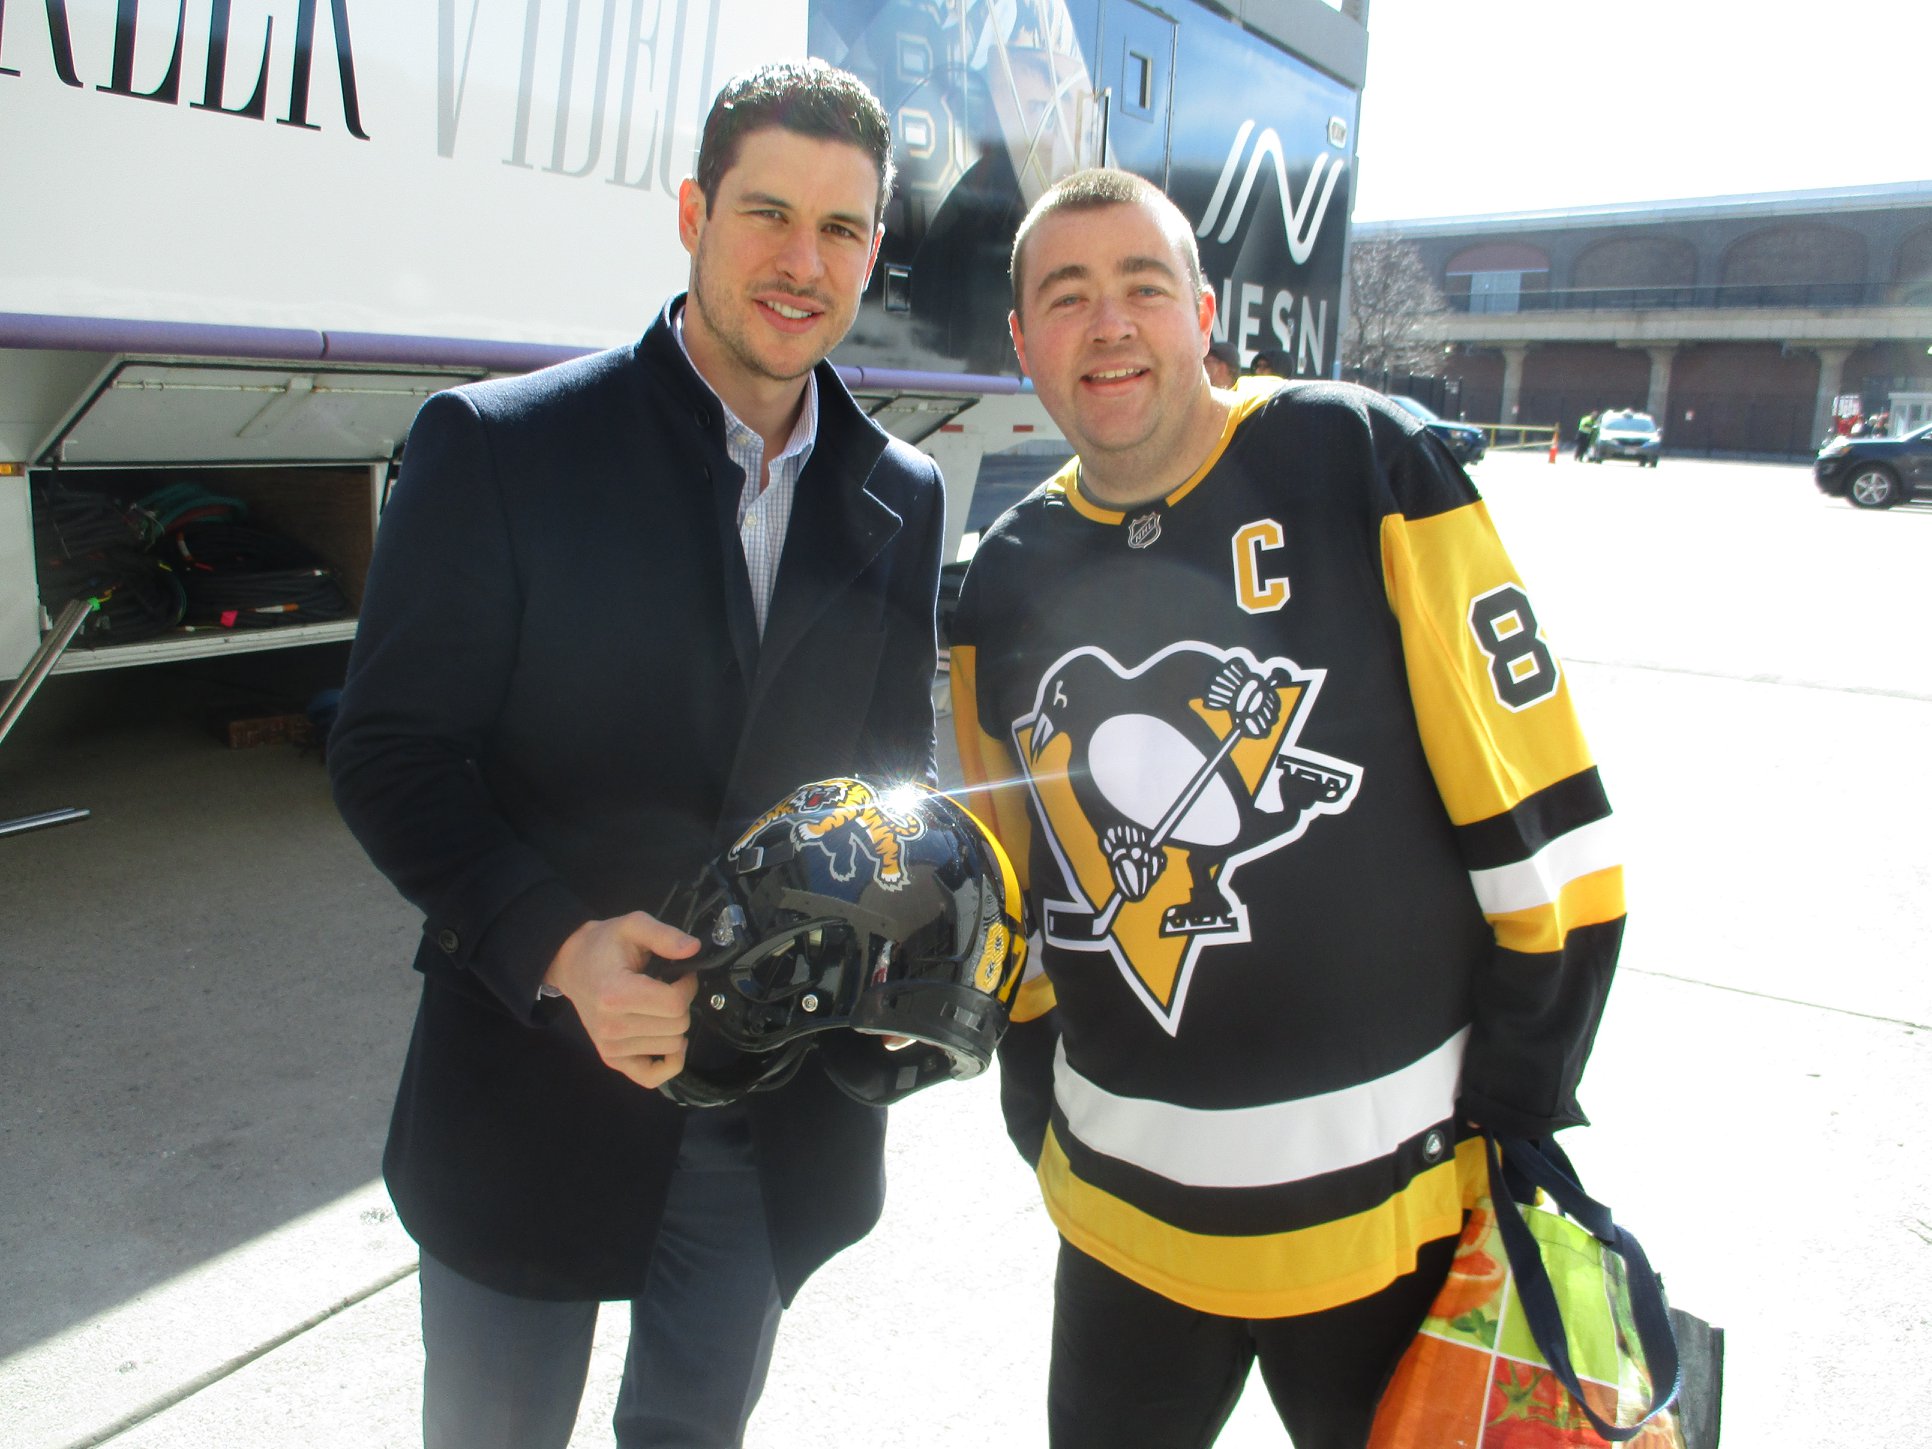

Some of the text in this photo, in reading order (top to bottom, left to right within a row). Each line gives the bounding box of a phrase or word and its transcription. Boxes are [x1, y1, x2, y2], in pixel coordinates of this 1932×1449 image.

[1211, 278, 1328, 376] NESN
[1232, 518, 1290, 614] C
[1466, 581, 1561, 713] 8
